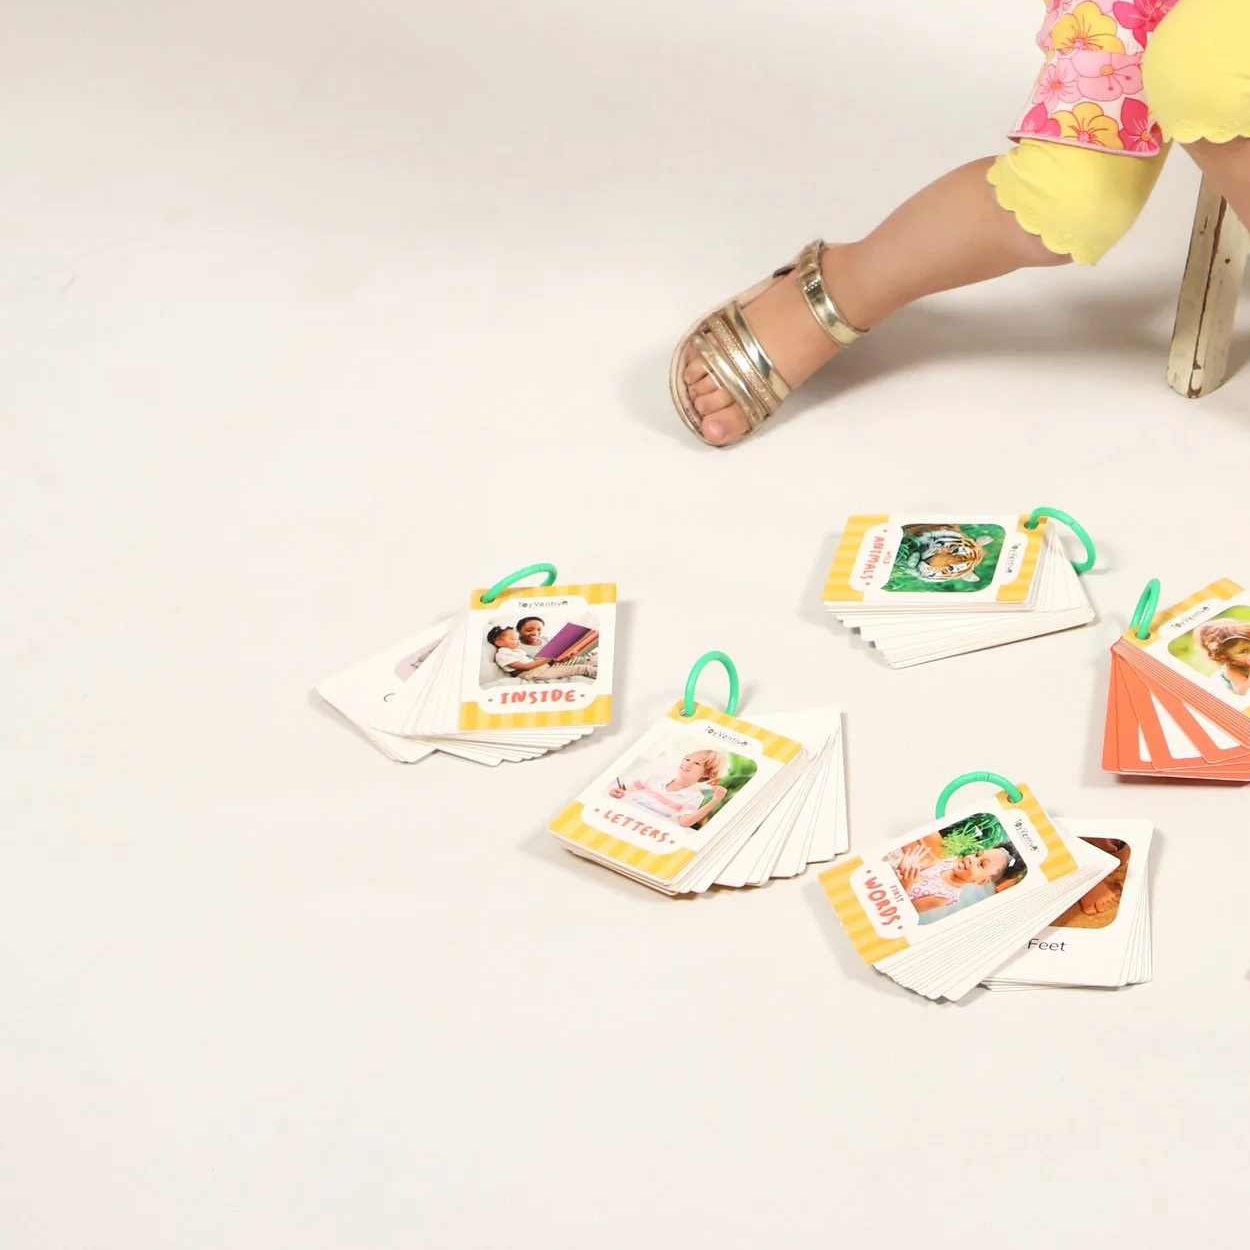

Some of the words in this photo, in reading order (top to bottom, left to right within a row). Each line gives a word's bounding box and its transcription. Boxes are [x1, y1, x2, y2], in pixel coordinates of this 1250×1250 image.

[860, 536, 886, 581] ANIMALS
[500, 689, 577, 705] INSIDE
[603, 808, 671, 843] LETTERS
[863, 876, 901, 926] WORDS
[889, 884, 904, 902] FIRST
[1027, 937, 1068, 952] Feet
